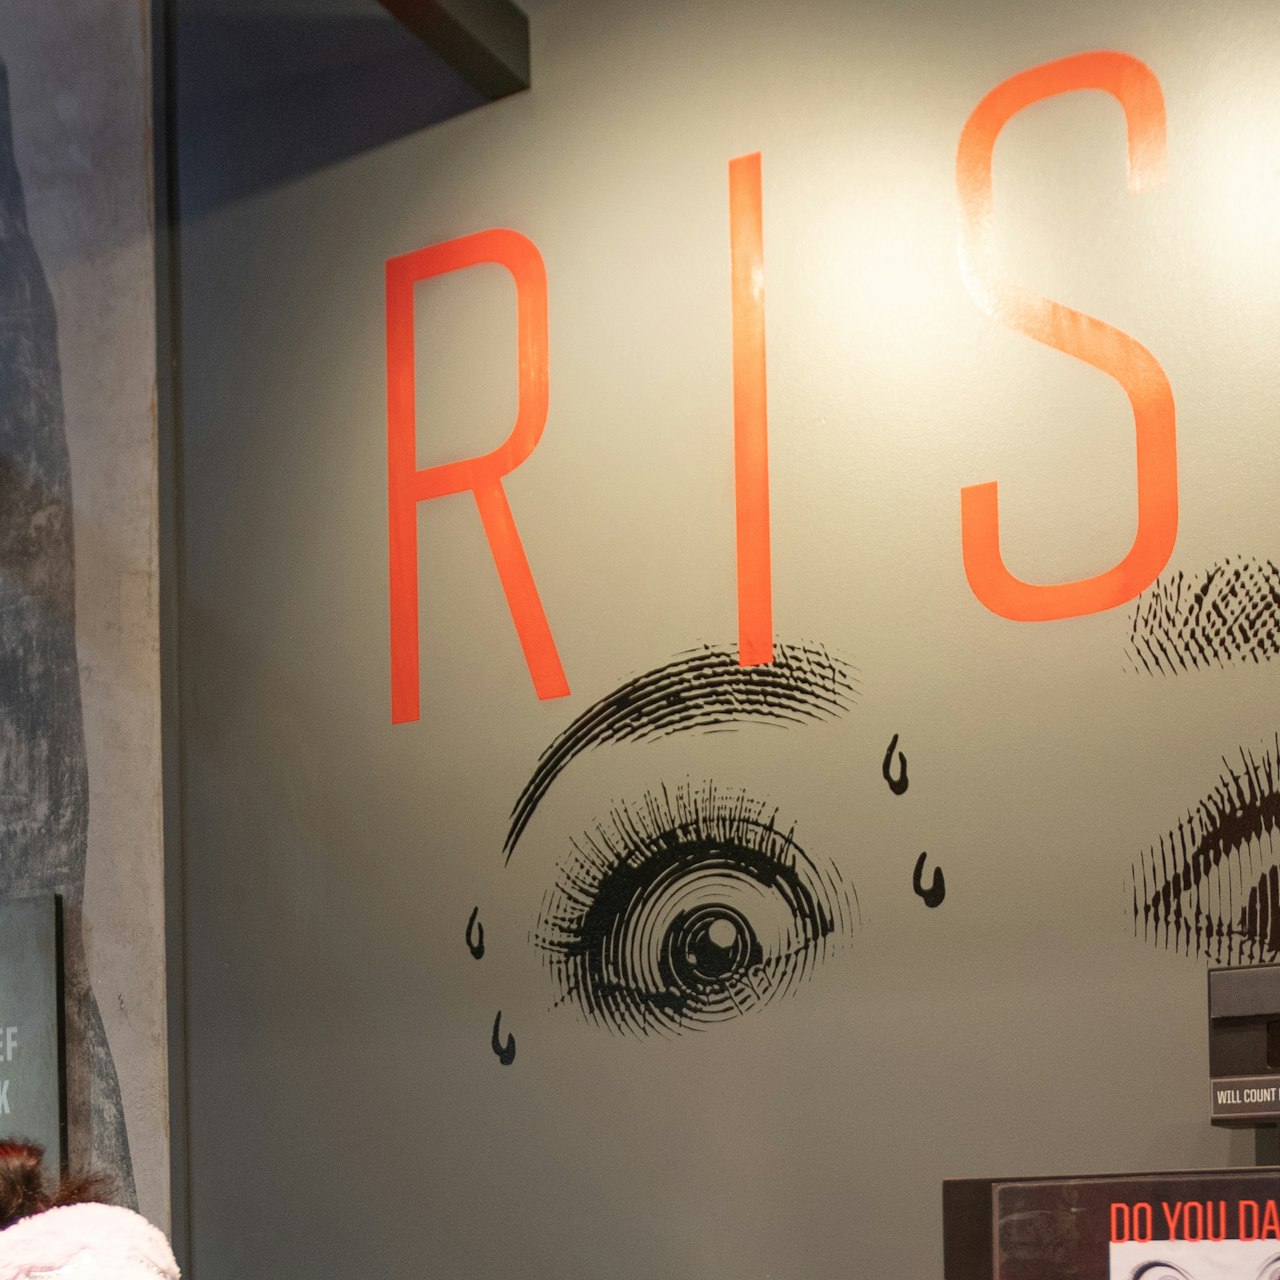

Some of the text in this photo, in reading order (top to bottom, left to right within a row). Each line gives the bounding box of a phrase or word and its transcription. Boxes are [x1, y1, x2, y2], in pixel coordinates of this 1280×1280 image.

[1217, 1089, 1242, 1104] WILL
[1244, 1087, 1276, 1102] COUNT
[1110, 1202, 1152, 1243] DO
[1162, 1201, 1226, 1242] YOU
